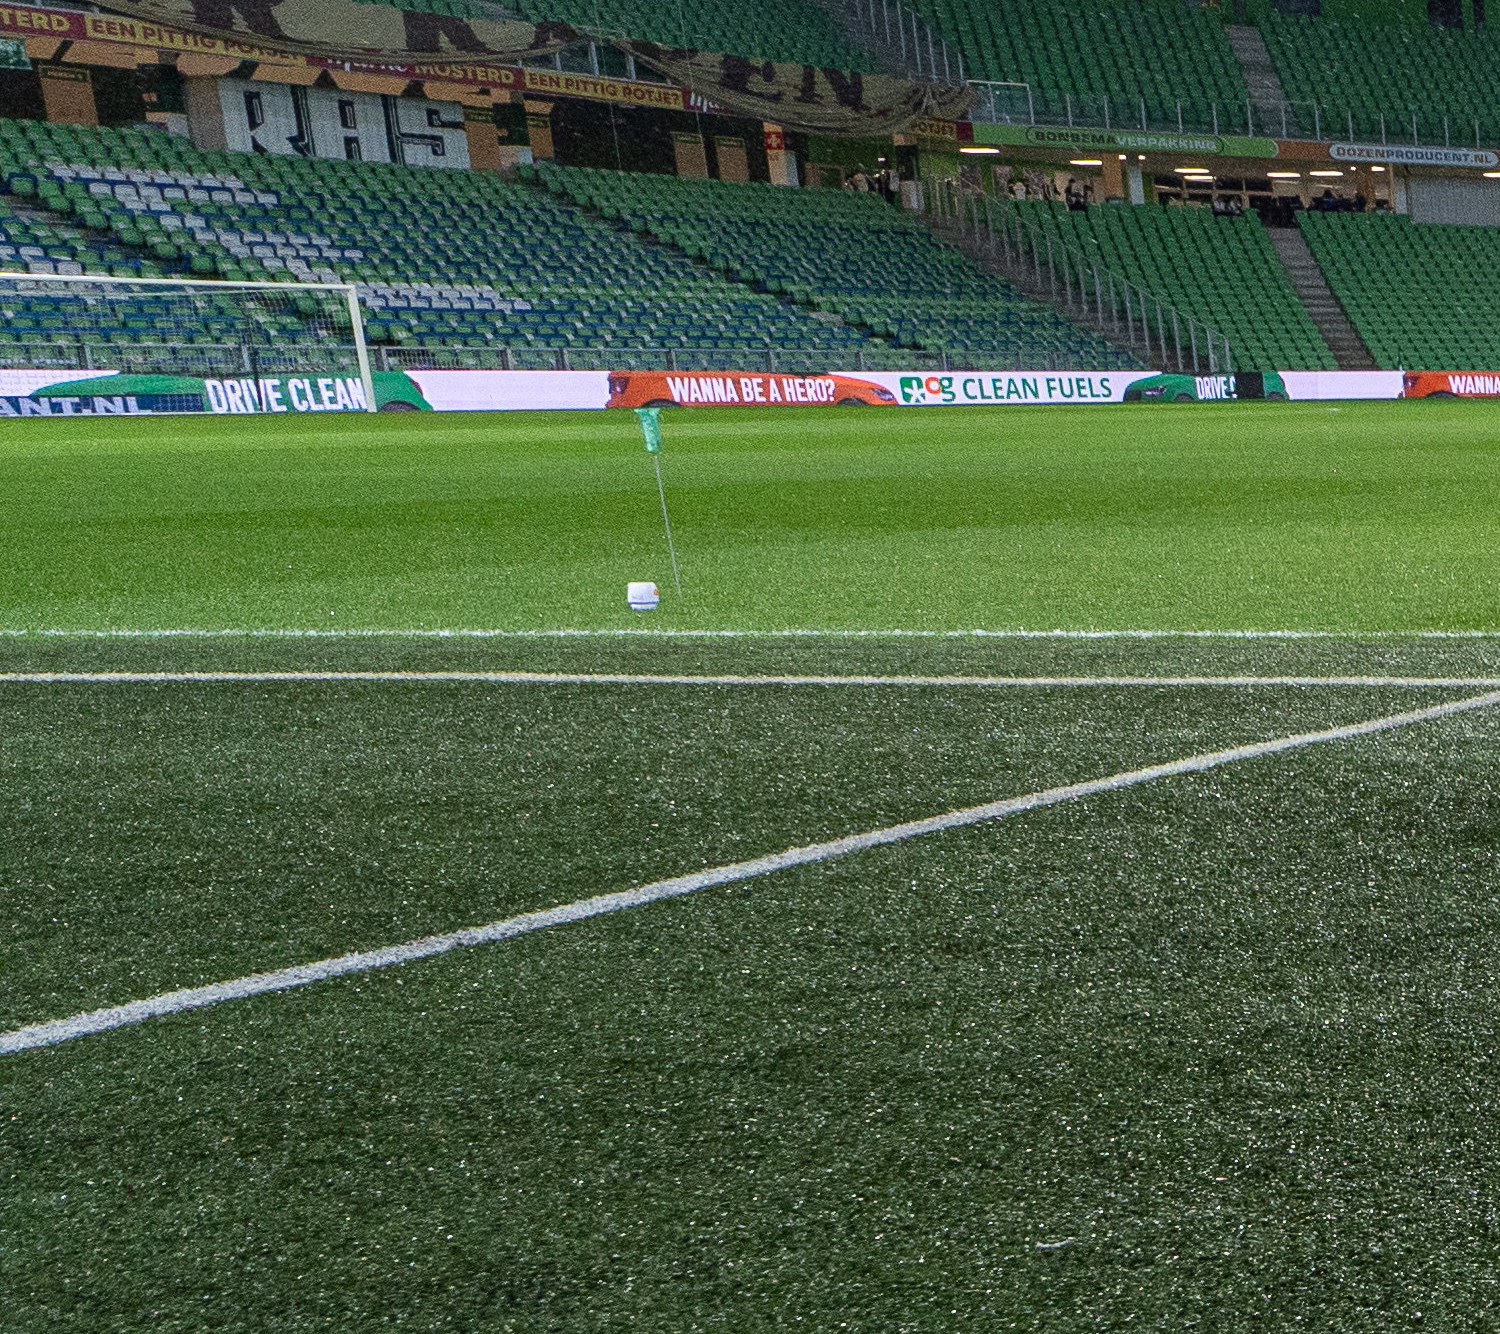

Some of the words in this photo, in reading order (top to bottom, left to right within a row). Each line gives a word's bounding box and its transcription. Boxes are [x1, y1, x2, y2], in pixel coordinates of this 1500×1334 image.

[93, 19, 137, 39] EEN
[143, 26, 217, 50] PITTIG
[414, 63, 516, 85] MOSTERD
[527, 74, 561, 89] EEN
[565, 79, 618, 97] PITTIG
[622, 85, 680, 105] POTJE?
[1335, 147, 1493, 164] DOZENPRODUCENT.NL
[204, 378, 288, 412] DRIVE
[667, 376, 740, 402] WANNA
[740, 378, 767, 403] BE
[769, 378, 782, 403] A
[783, 378, 836, 403] HERO?
[962, 378, 1039, 400] CLEAN
[1046, 378, 1113, 399] FUELS
[1195, 375, 1229, 400] DRIVE
